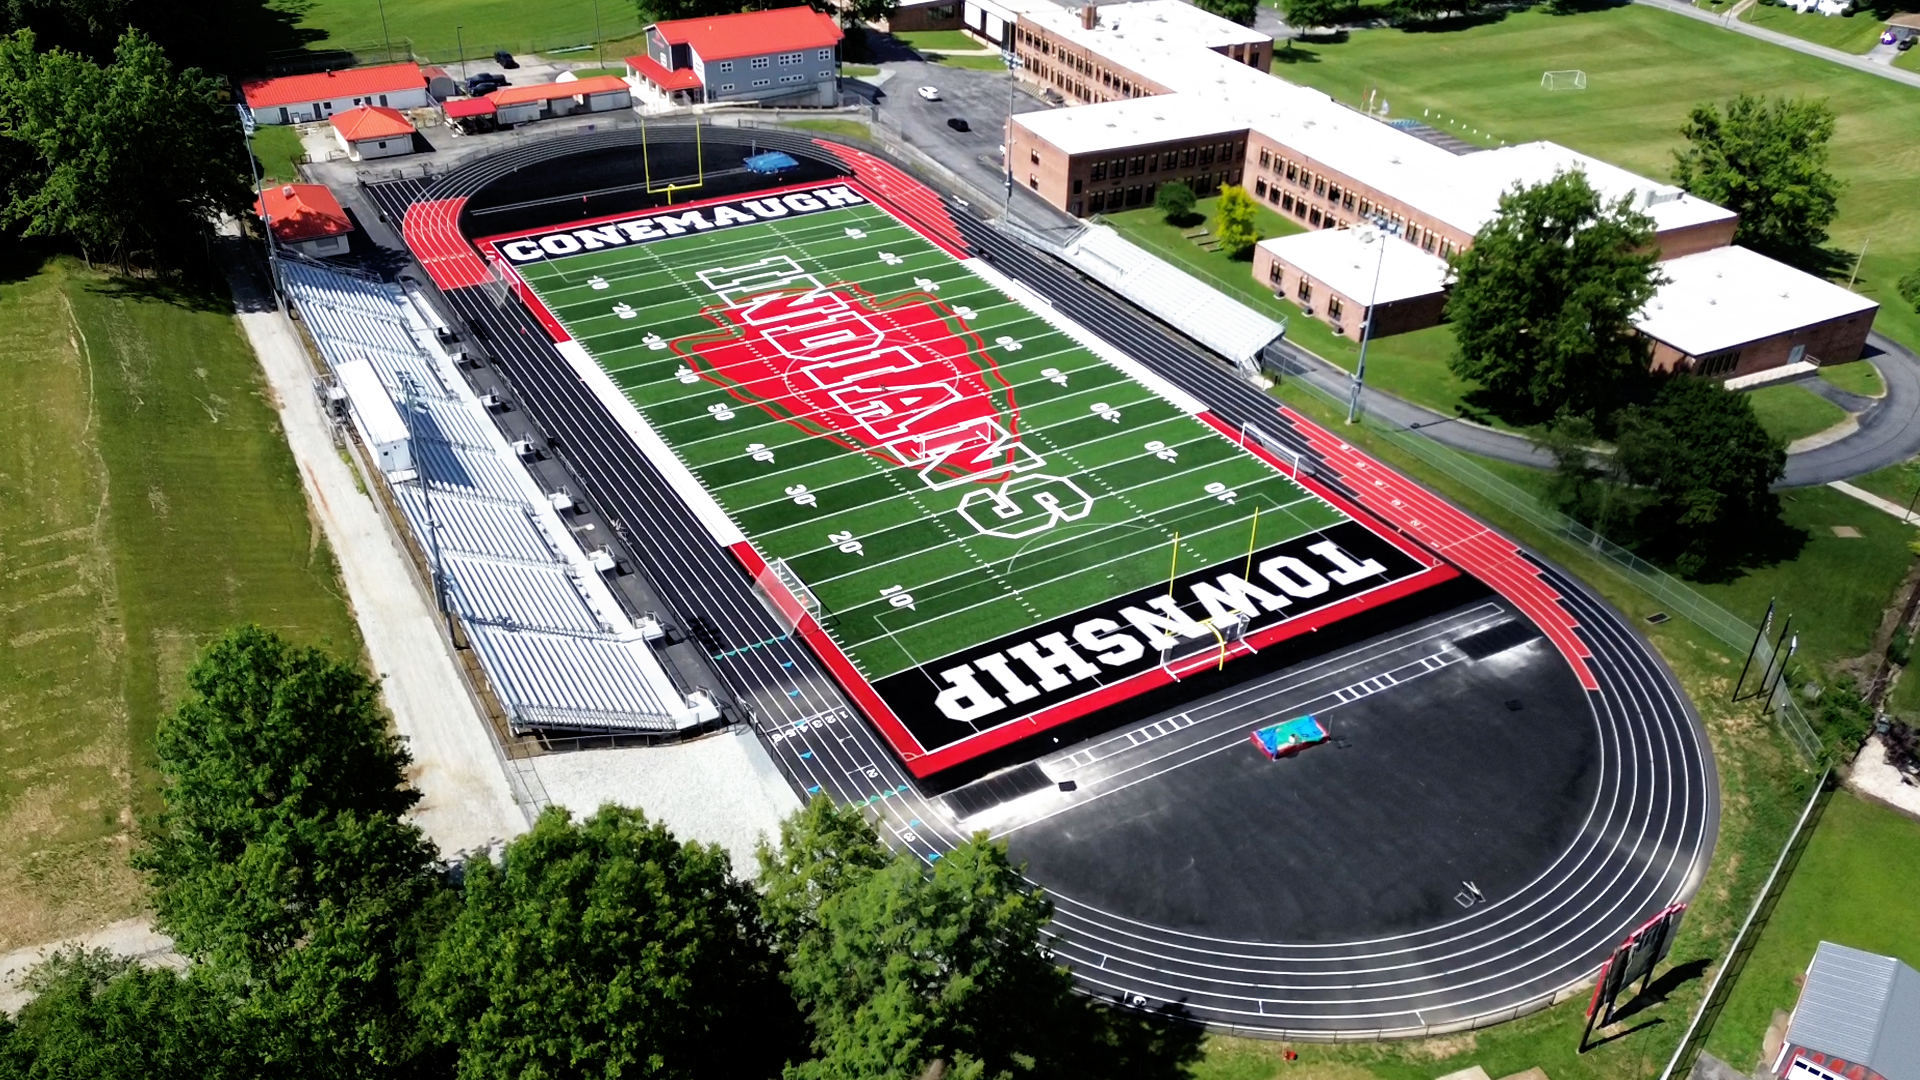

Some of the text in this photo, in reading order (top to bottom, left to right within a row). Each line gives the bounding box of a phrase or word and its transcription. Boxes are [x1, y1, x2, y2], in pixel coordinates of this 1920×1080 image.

[503, 186, 863, 261] CONEMAUGH
[696, 254, 1093, 539] INDIANS
[708, 403, 735, 420] 50
[1090, 402, 1121, 420] 30
[745, 444, 774, 461] 40
[1144, 441, 1178, 460] 20
[785, 484, 816, 504] 30
[1204, 482, 1237, 500] 10
[828, 531, 862, 553] 20
[880, 585, 913, 607] 10
[935, 540, 1387, 722] TOWNSHIP
[812, 720, 823, 728] 3
[825, 715, 836, 724] 2
[866, 768, 878, 778] 2
